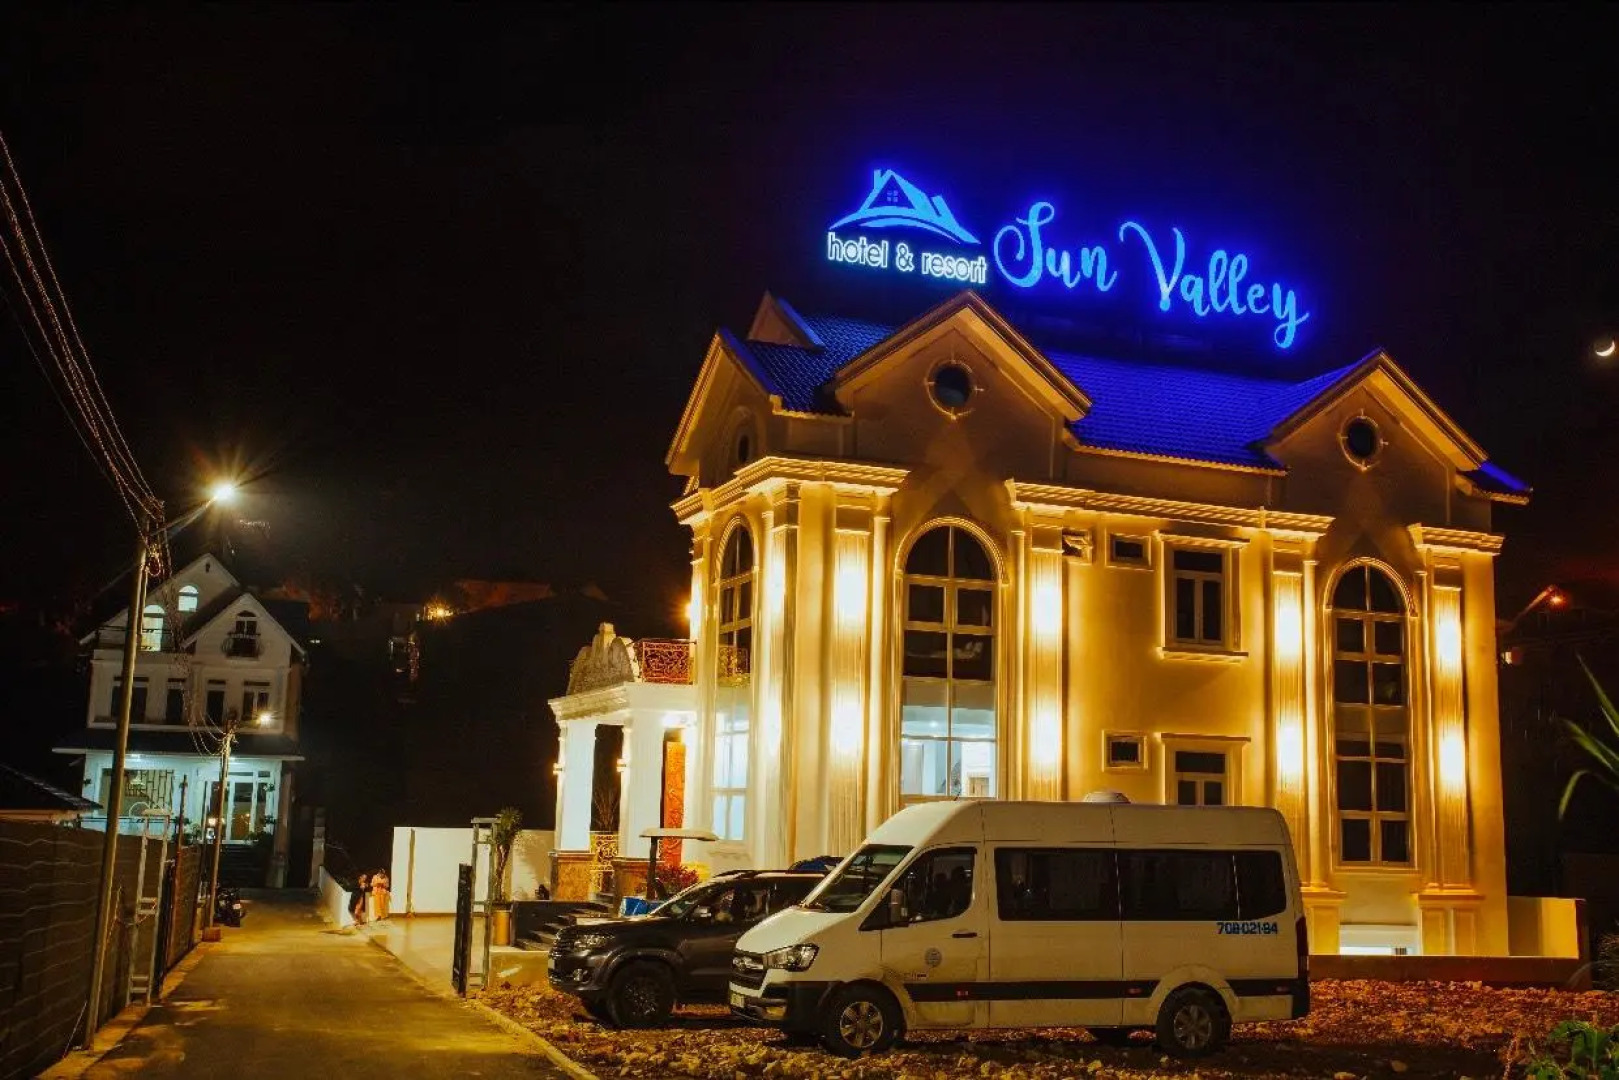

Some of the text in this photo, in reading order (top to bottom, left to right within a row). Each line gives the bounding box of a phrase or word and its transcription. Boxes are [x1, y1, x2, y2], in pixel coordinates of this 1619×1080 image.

[827, 231, 987, 284] hotel & resort
[994, 202, 1309, 348] Sun Valley
